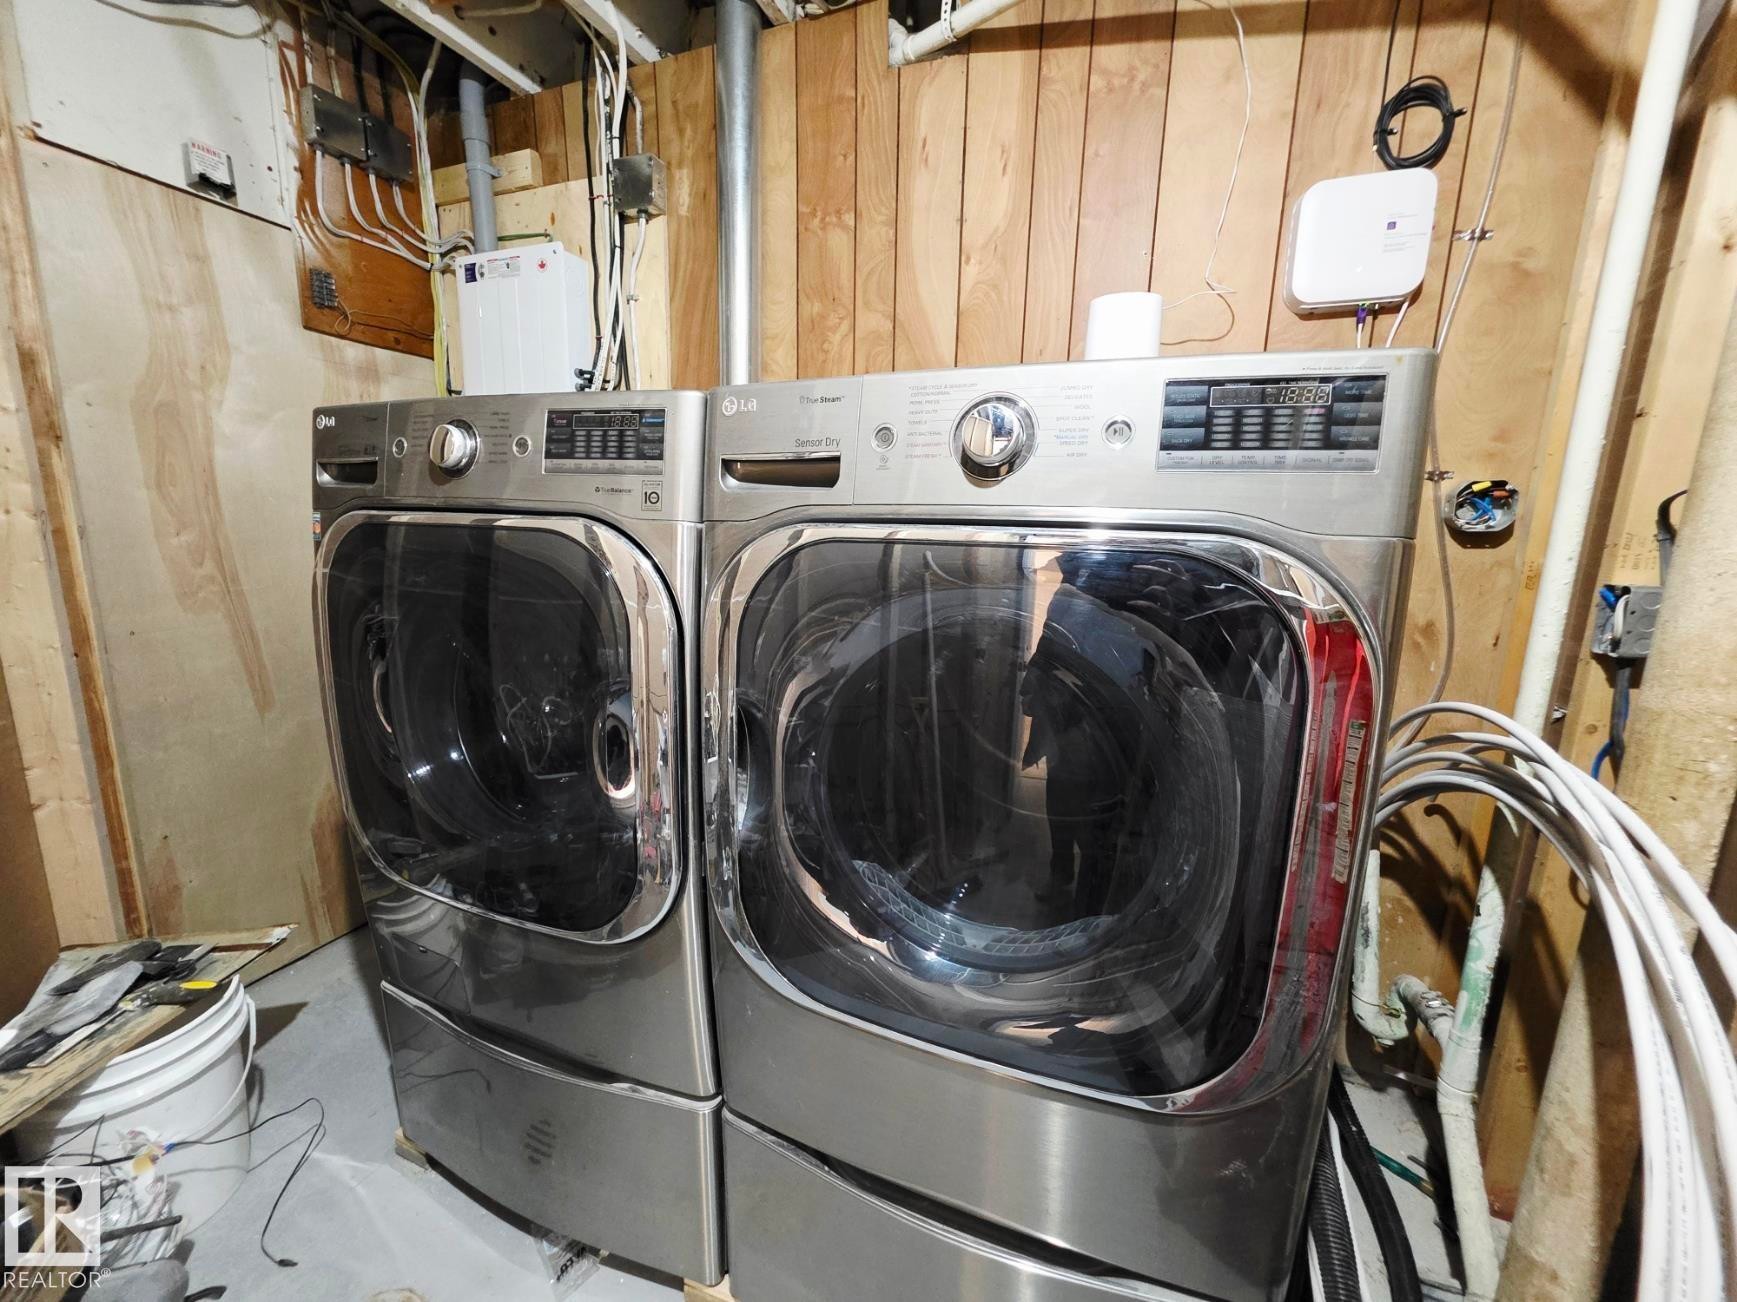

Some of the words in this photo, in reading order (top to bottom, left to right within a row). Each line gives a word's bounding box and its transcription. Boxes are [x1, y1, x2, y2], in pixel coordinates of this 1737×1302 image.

[795, 438, 823, 448] Sensor
[825, 437, 841, 448] Dry
[644, 491, 660, 505] 10
